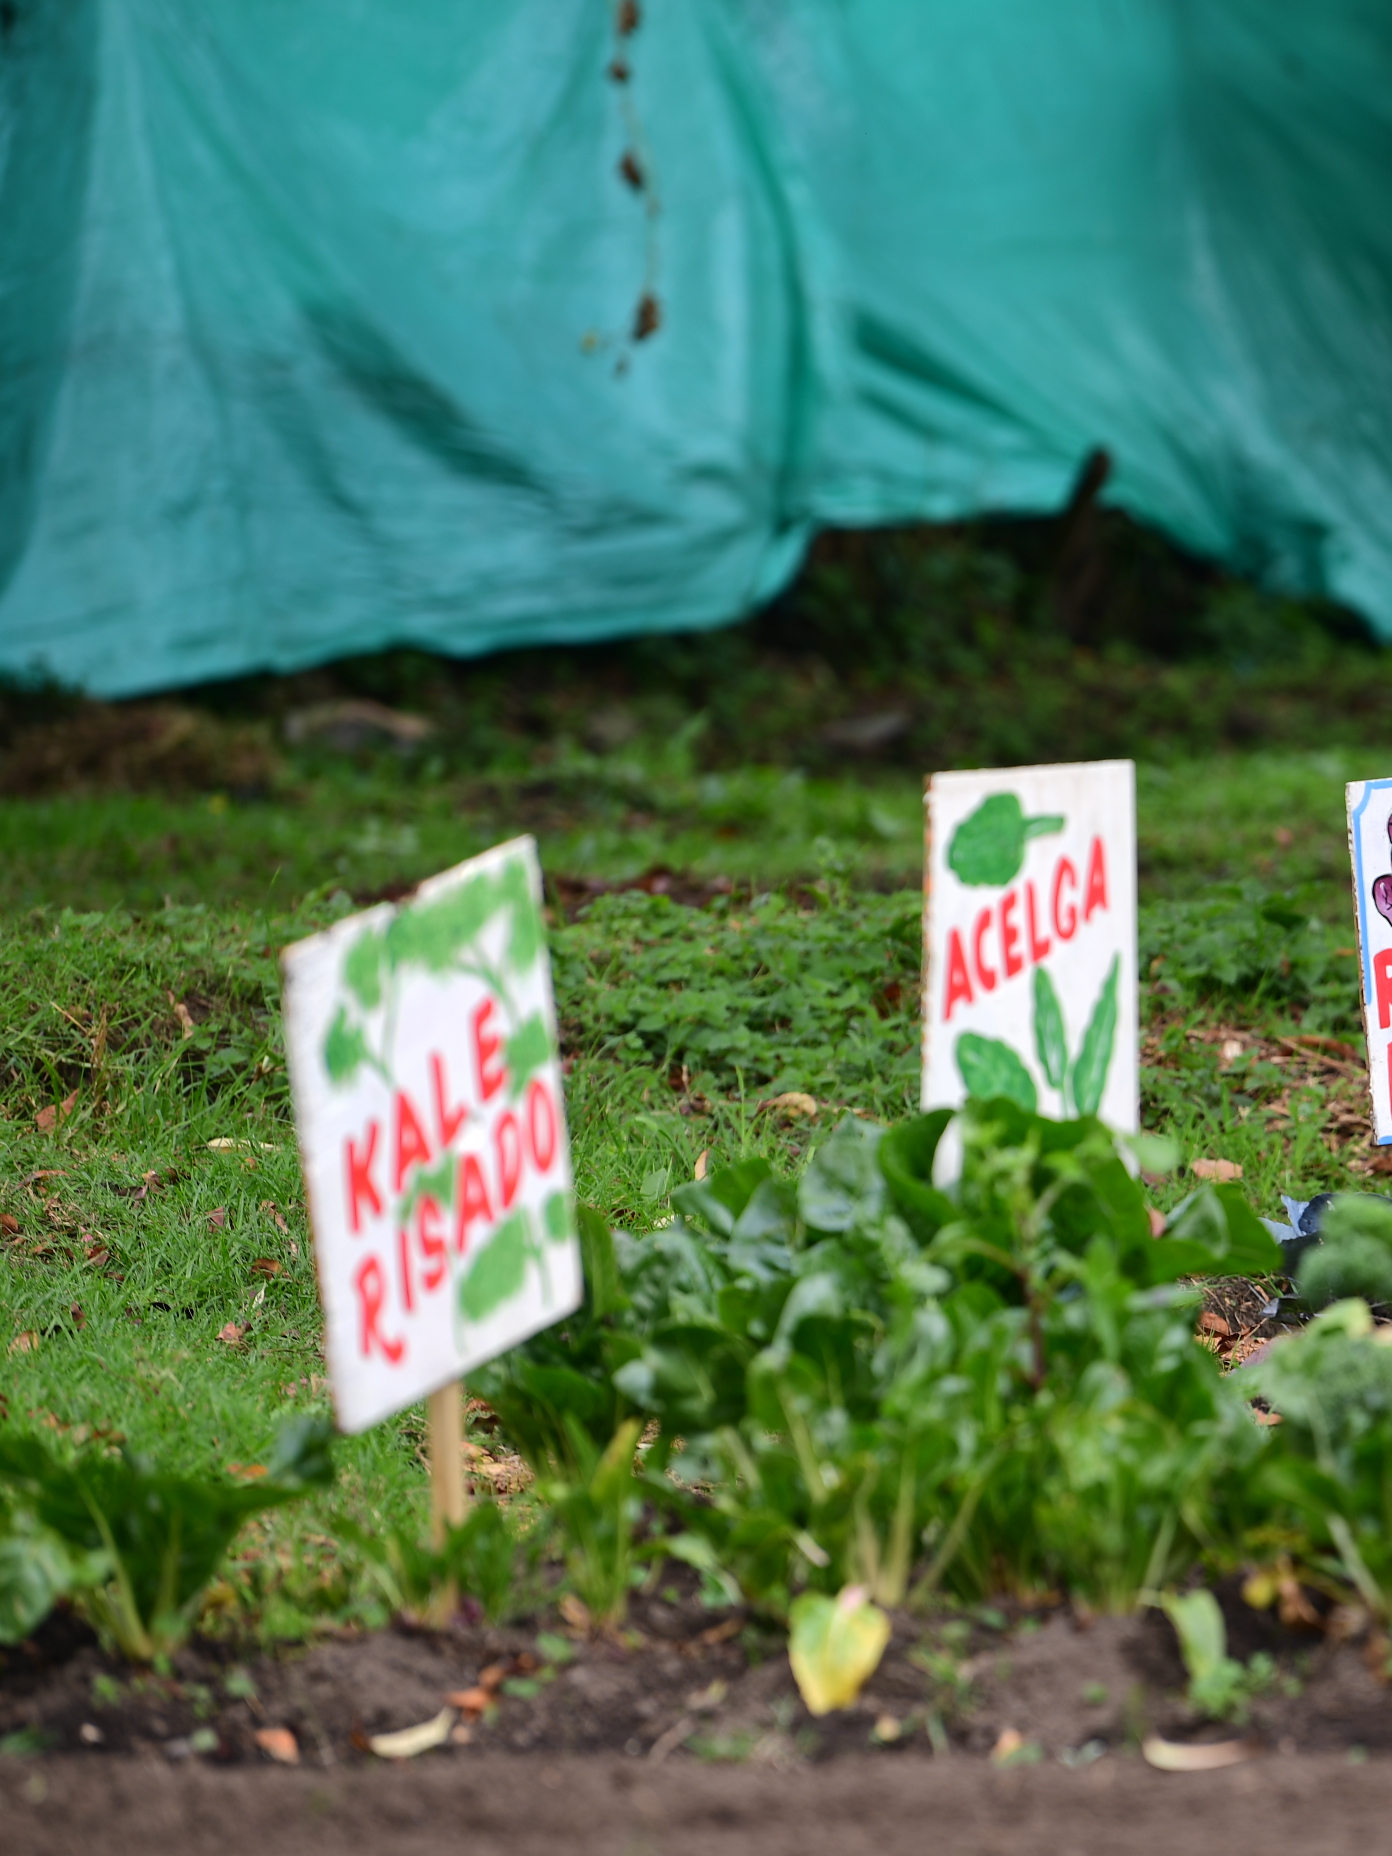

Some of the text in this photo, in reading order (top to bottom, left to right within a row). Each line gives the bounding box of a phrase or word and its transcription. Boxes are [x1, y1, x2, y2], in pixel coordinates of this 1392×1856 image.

[942, 835, 1108, 1022] ACELGA
[343, 995, 507, 1234] KALE
[354, 1078, 558, 1364] RISADO
